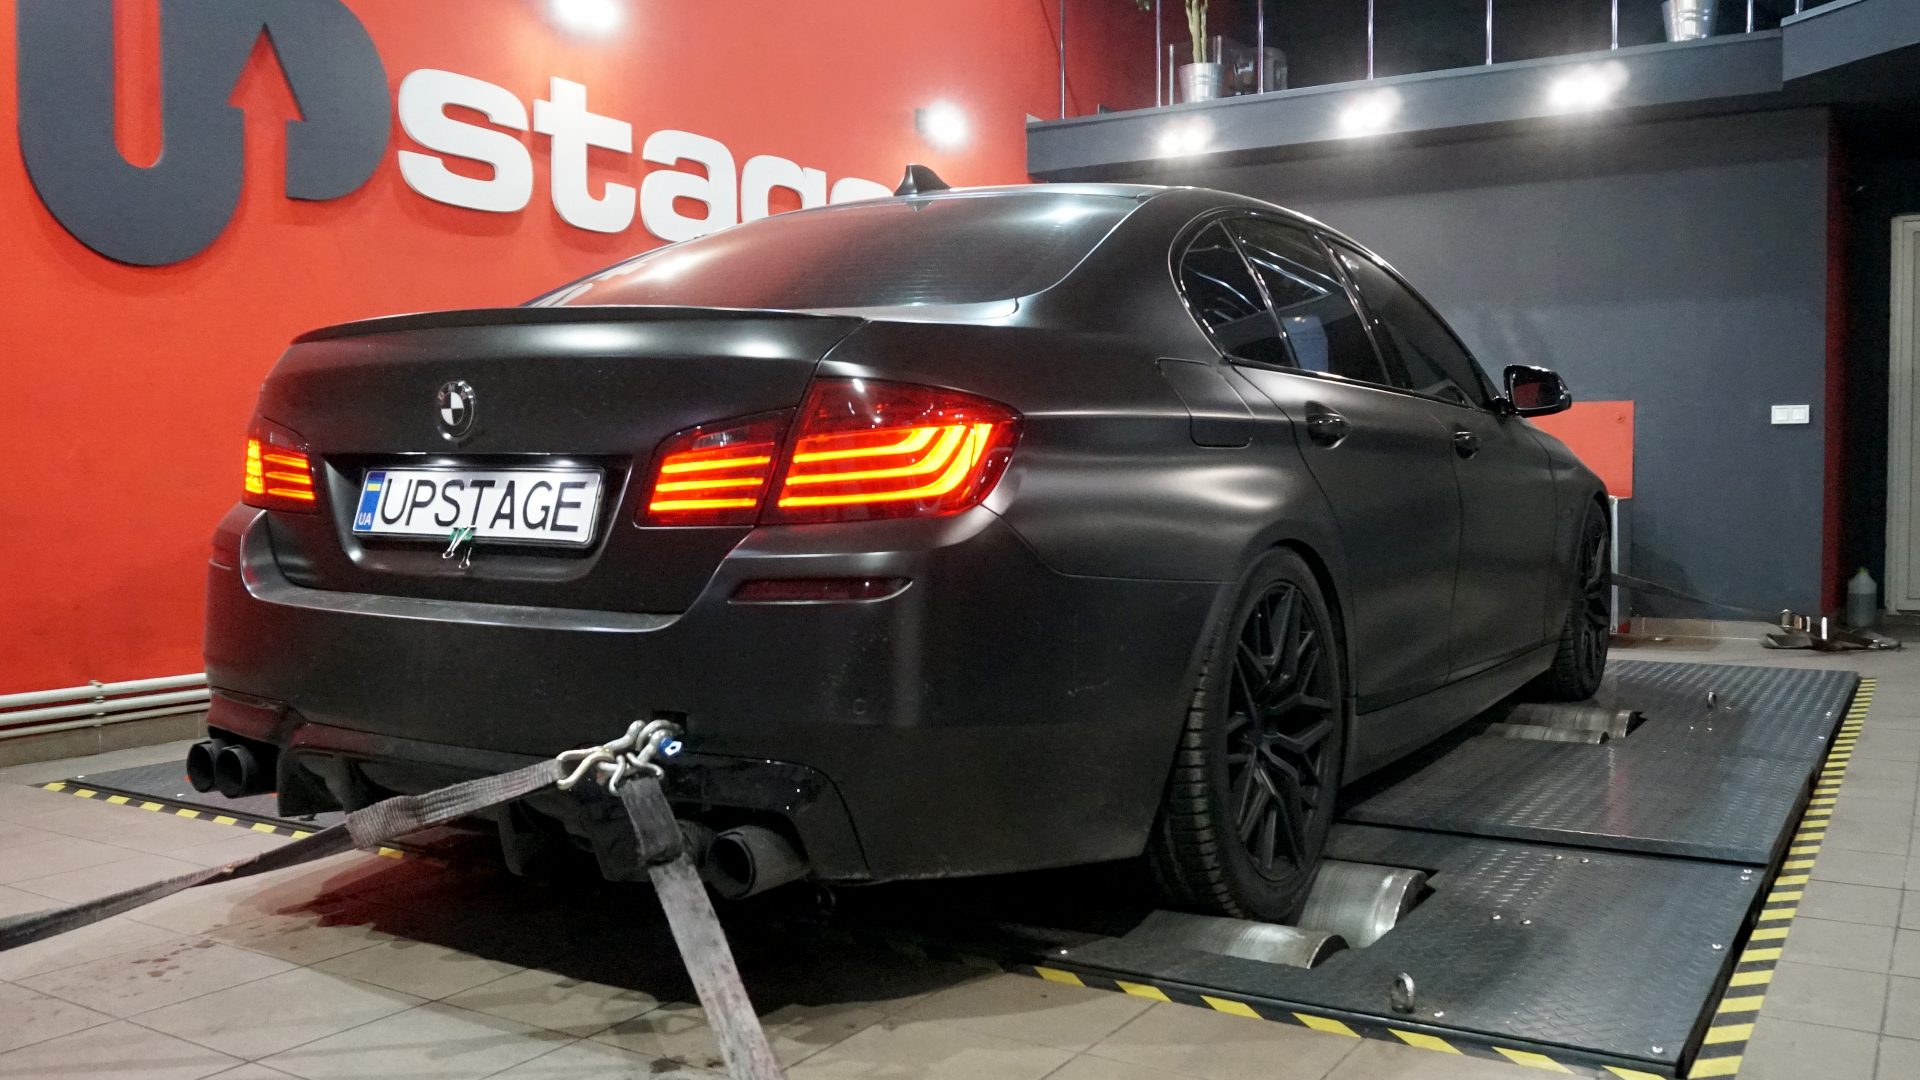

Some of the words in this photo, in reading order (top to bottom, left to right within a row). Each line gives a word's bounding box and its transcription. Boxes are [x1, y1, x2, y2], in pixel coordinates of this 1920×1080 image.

[398, 68, 895, 242] sta
[358, 511, 372, 526] UA
[380, 478, 588, 532] UPSTAGE
